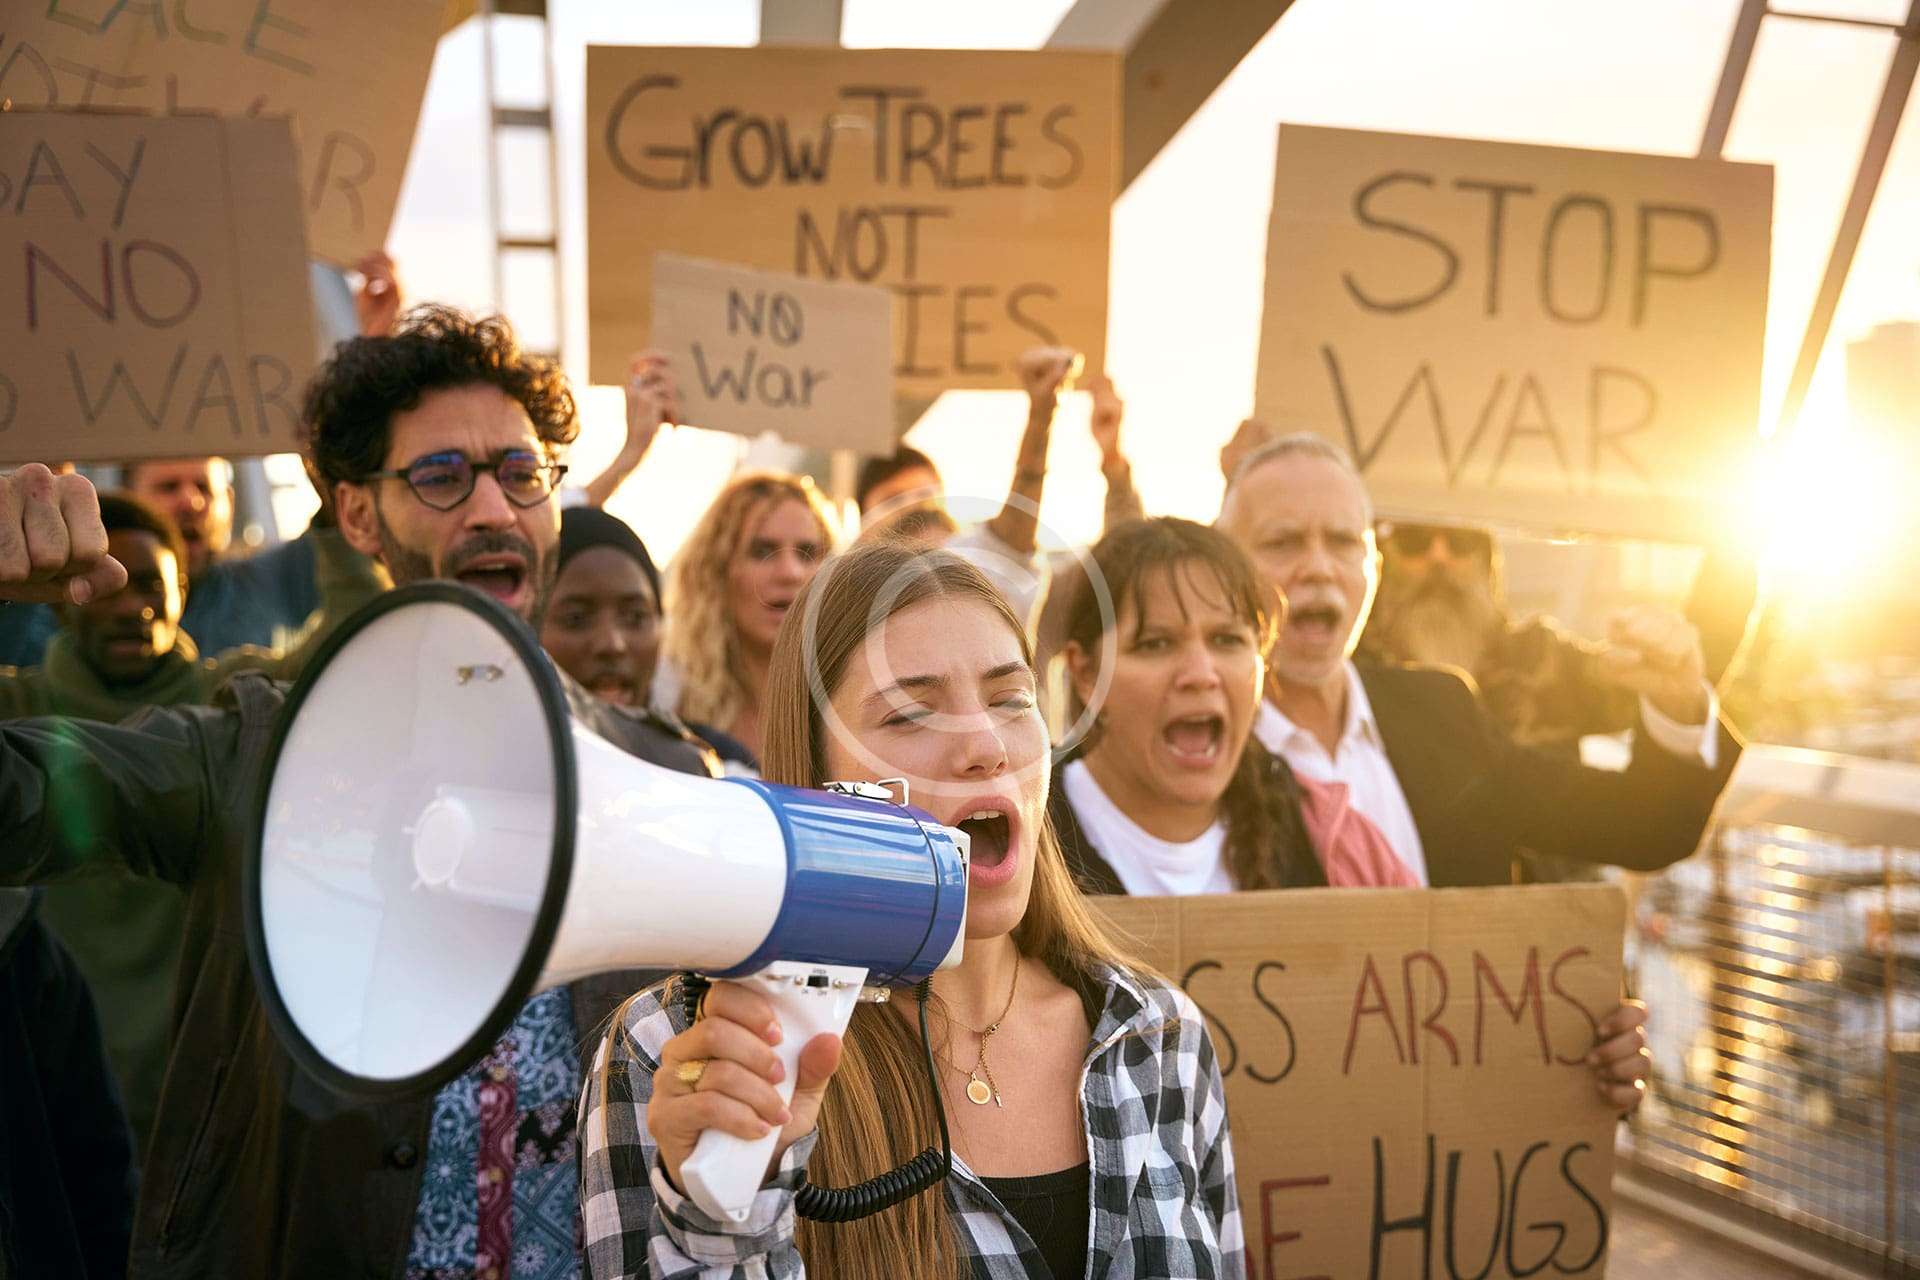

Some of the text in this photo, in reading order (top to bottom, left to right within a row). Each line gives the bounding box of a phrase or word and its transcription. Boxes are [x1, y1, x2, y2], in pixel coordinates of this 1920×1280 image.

[606, 74, 1085, 191] Grow TREES
[24, 238, 201, 334] NO
[796, 205, 952, 282] NOT
[1341, 168, 1722, 329] STOP
[65, 340, 303, 438] WAR
[691, 340, 832, 408] War
[1320, 343, 1659, 492] WAR
[1341, 945, 1600, 1077] ARMS
[1246, 1133, 1610, 1280] E HUGS
